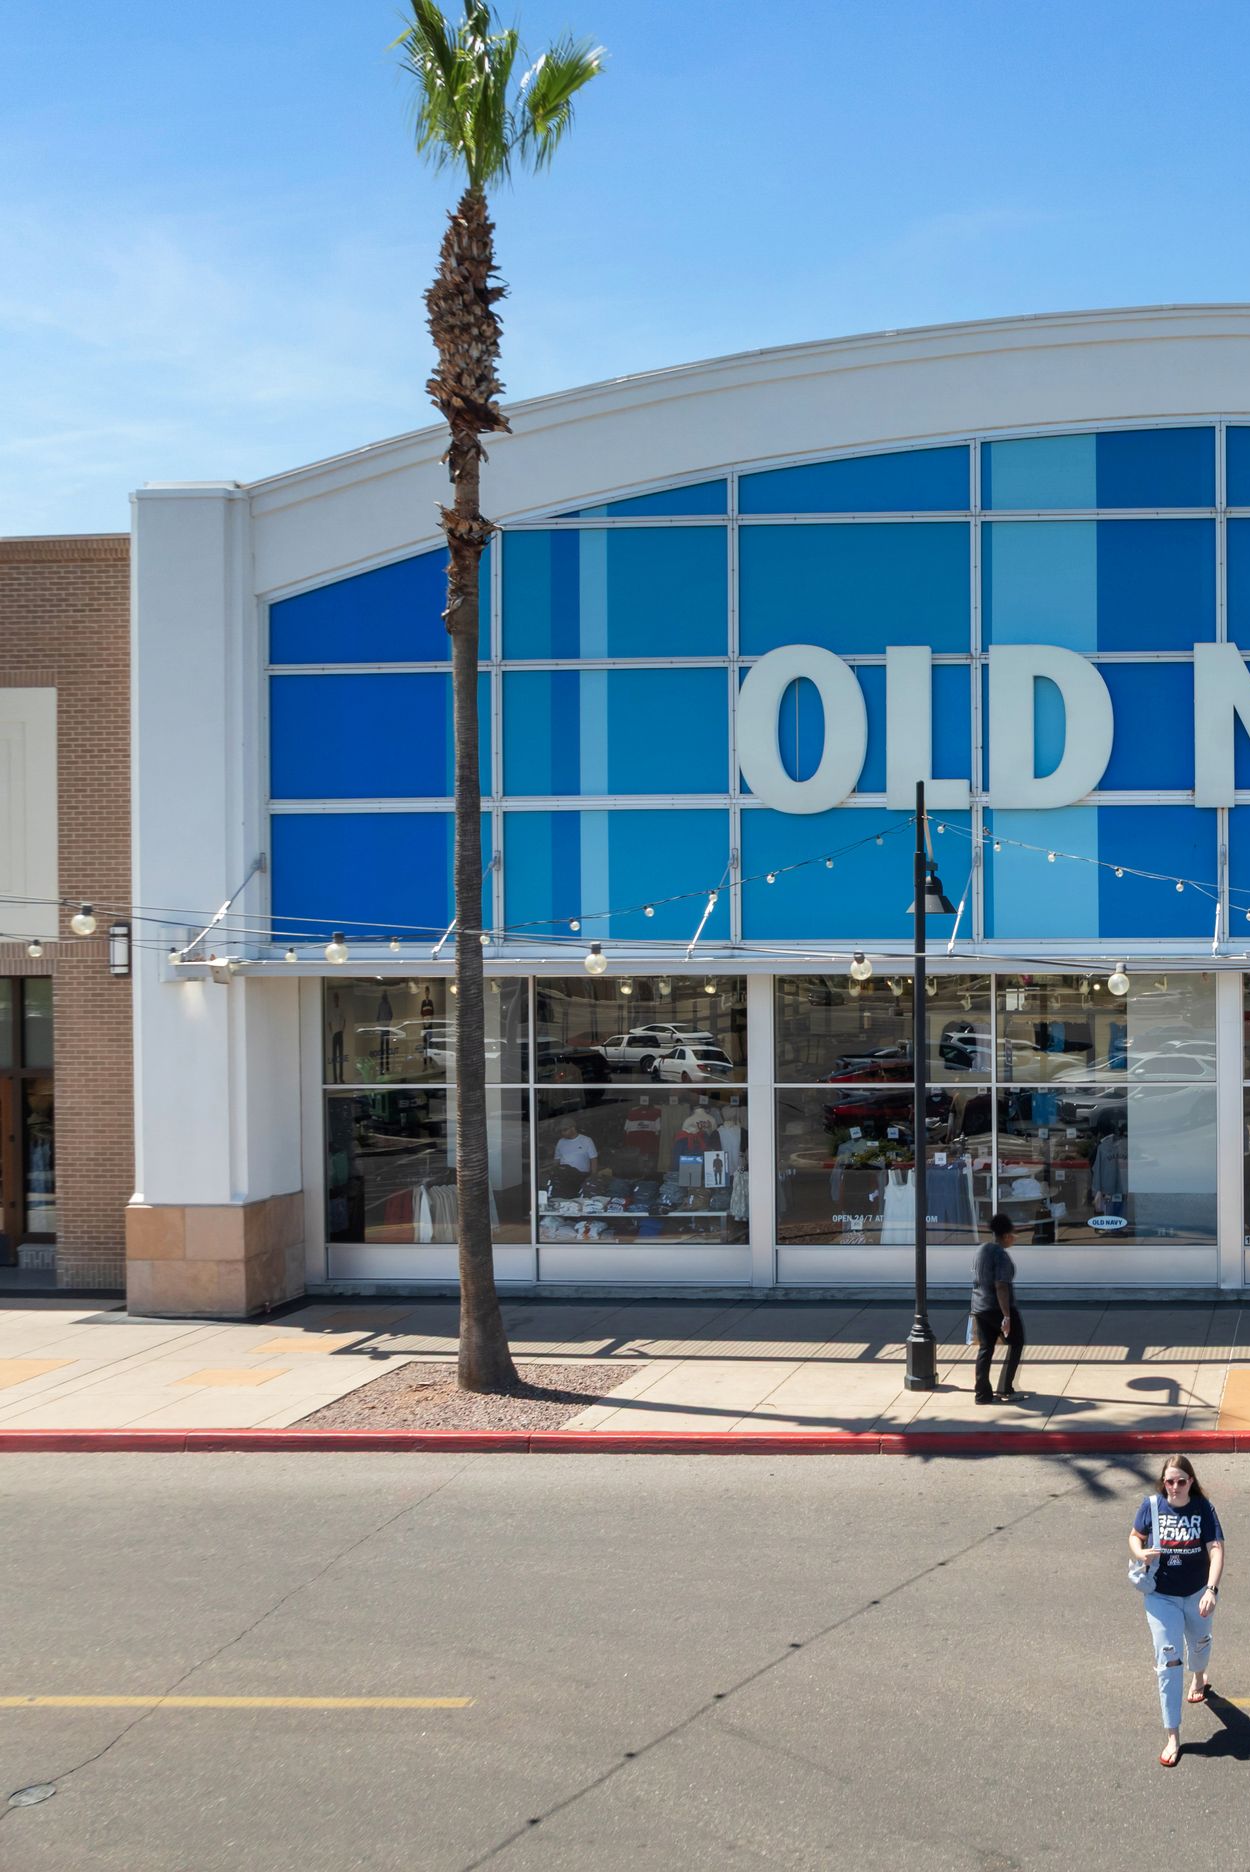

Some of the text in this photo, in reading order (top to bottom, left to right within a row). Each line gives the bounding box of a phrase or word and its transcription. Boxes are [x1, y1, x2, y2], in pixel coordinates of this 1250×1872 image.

[738, 644, 1114, 815] OLD
[832, 1214, 853, 1223] OPEN
[854, 1214, 873, 1223] 24/7
